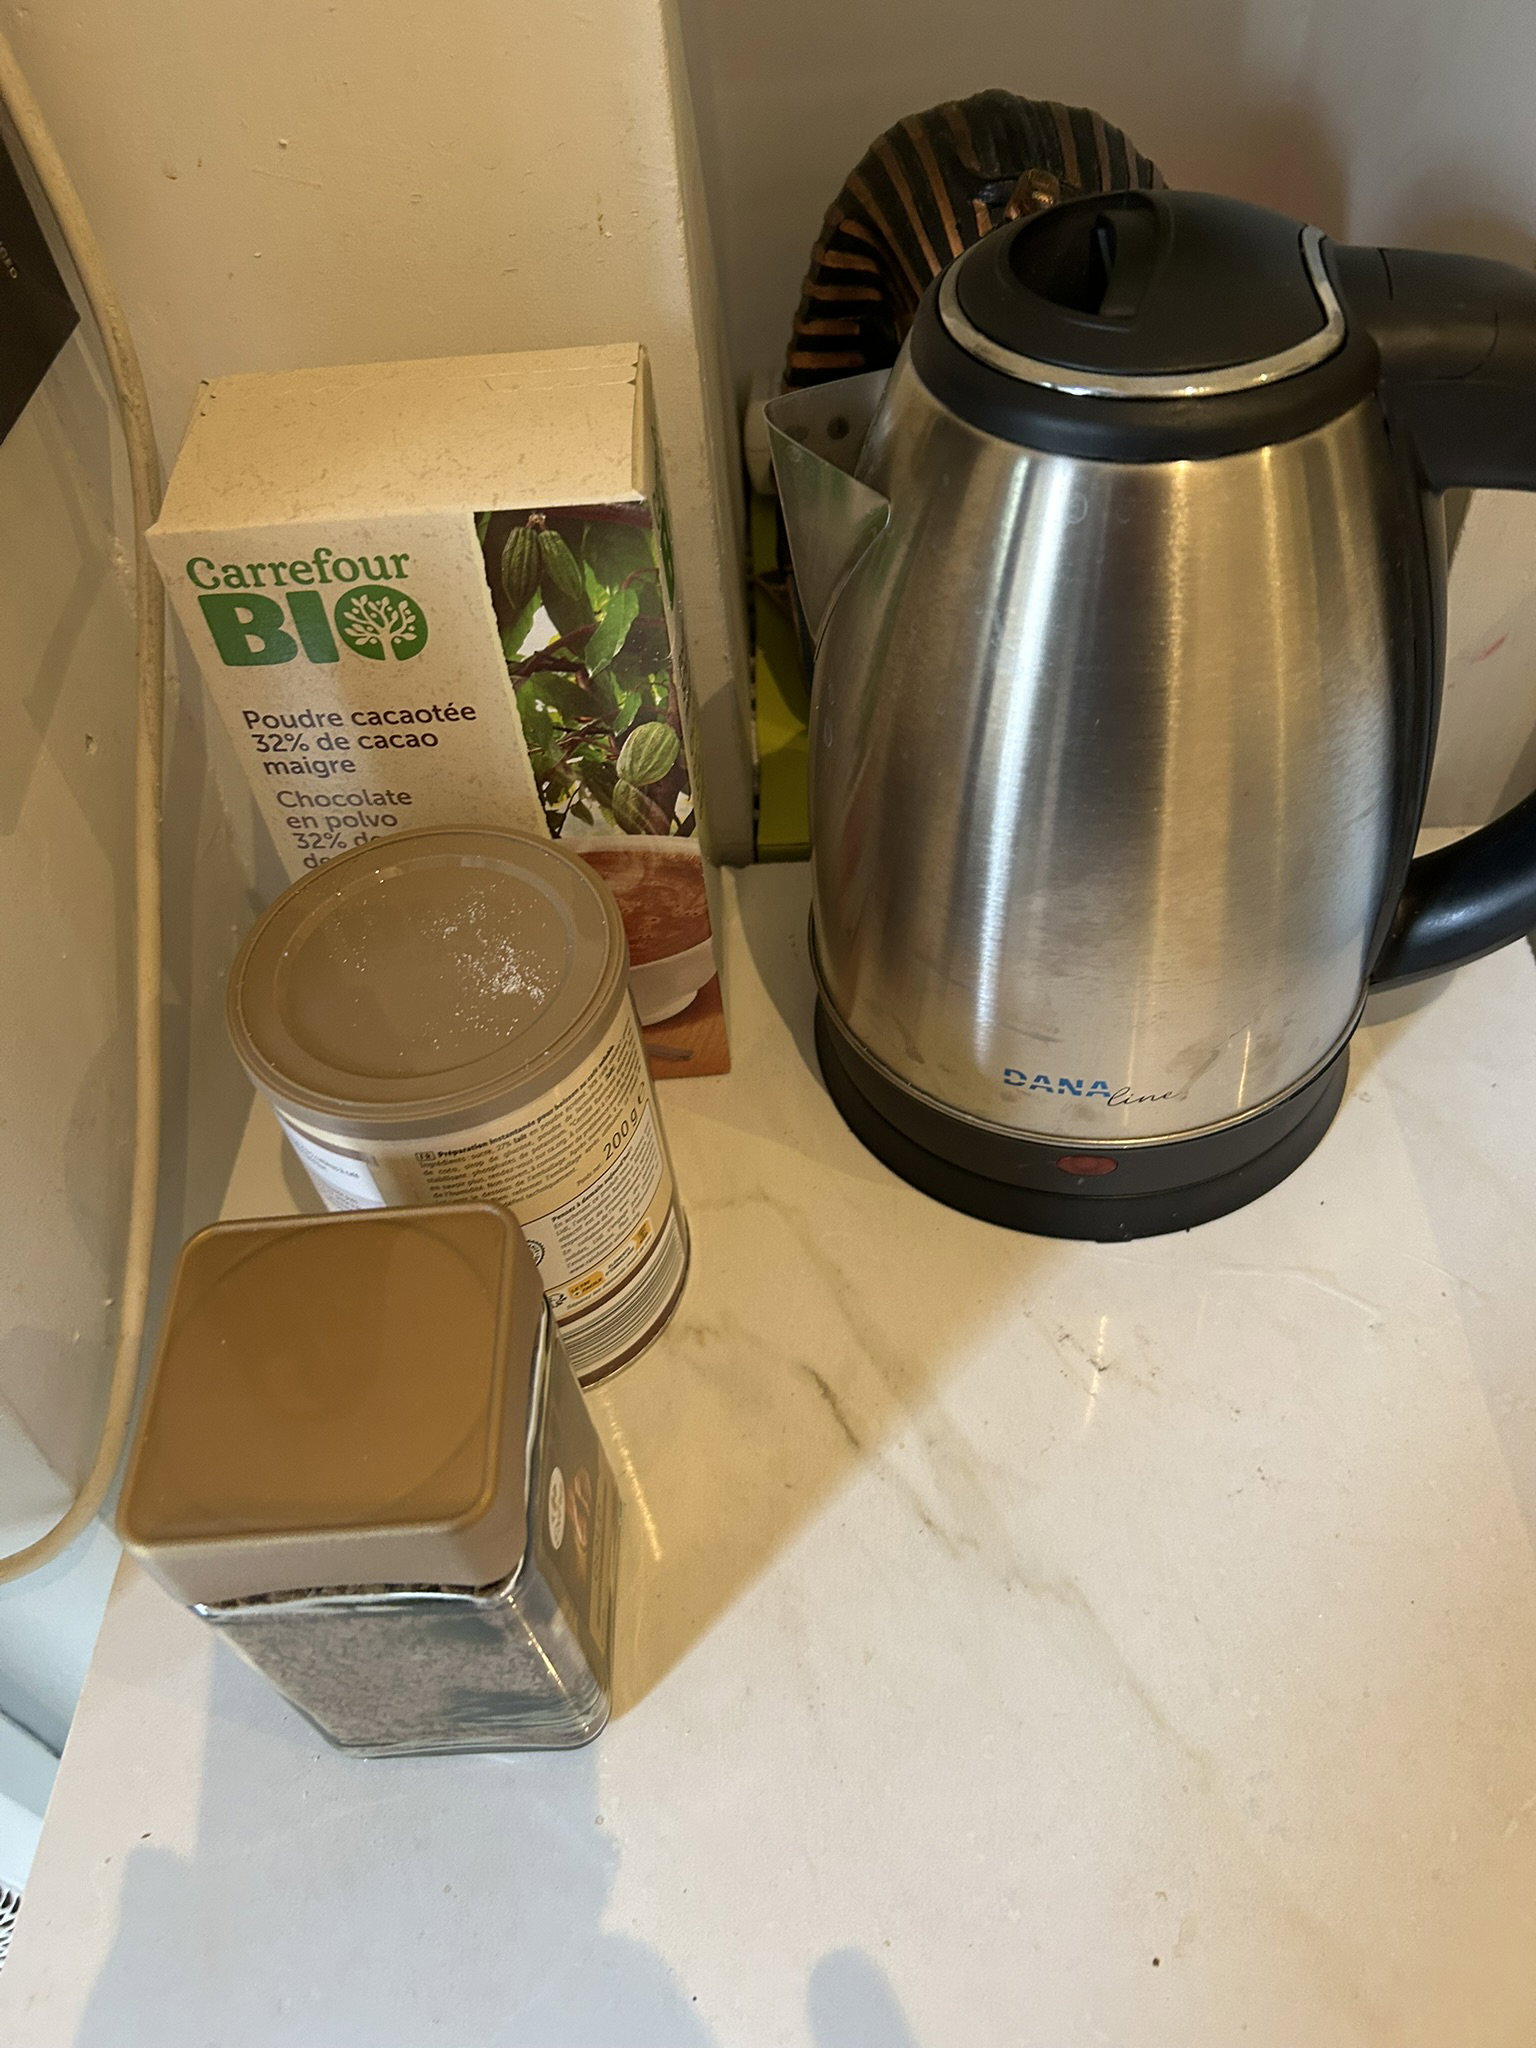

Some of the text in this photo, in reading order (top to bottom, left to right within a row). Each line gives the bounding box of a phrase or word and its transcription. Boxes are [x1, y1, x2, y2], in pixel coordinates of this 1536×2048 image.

[186, 547, 411, 592] Carrefour
[198, 584, 428, 667] BIO
[242, 702, 476, 731] Poudre cacaotée
[254, 731, 438, 754] 32% de cacao
[263, 756, 356, 780] maigre
[277, 788, 412, 808] Chocolate
[286, 810, 398, 832] en polvo
[292, 832, 347, 849] 32%
[1004, 1067, 1180, 1107] DANA line
[602, 1120, 630, 1161] 200
[630, 1107, 638, 1127] g
[437, 1139, 488, 1158] Préparation
